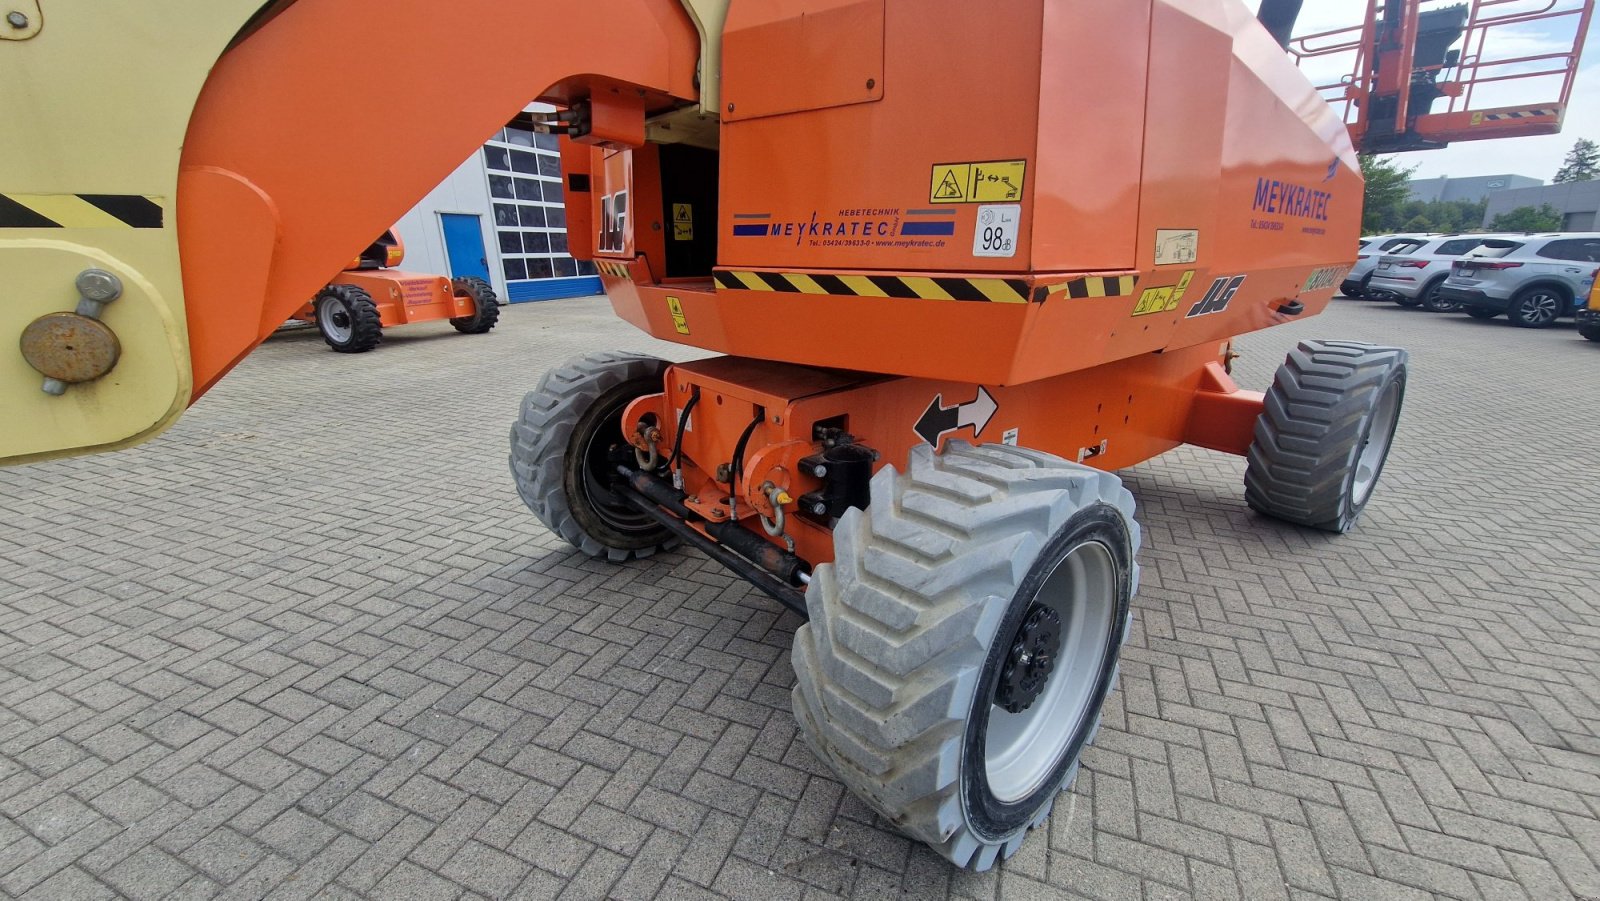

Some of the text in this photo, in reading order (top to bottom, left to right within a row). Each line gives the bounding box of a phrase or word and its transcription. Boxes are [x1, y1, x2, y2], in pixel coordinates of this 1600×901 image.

[1252, 177, 1332, 221] MEYKRATEC
[598, 189, 628, 253] JLG
[838, 208, 900, 217] HEBETECHNIK
[770, 219, 889, 240] MEYKRATEC
[982, 226, 1012, 251] 98 dB
[875, 239, 946, 249] www.meykratec.de
[1184, 275, 1248, 318] JLG
